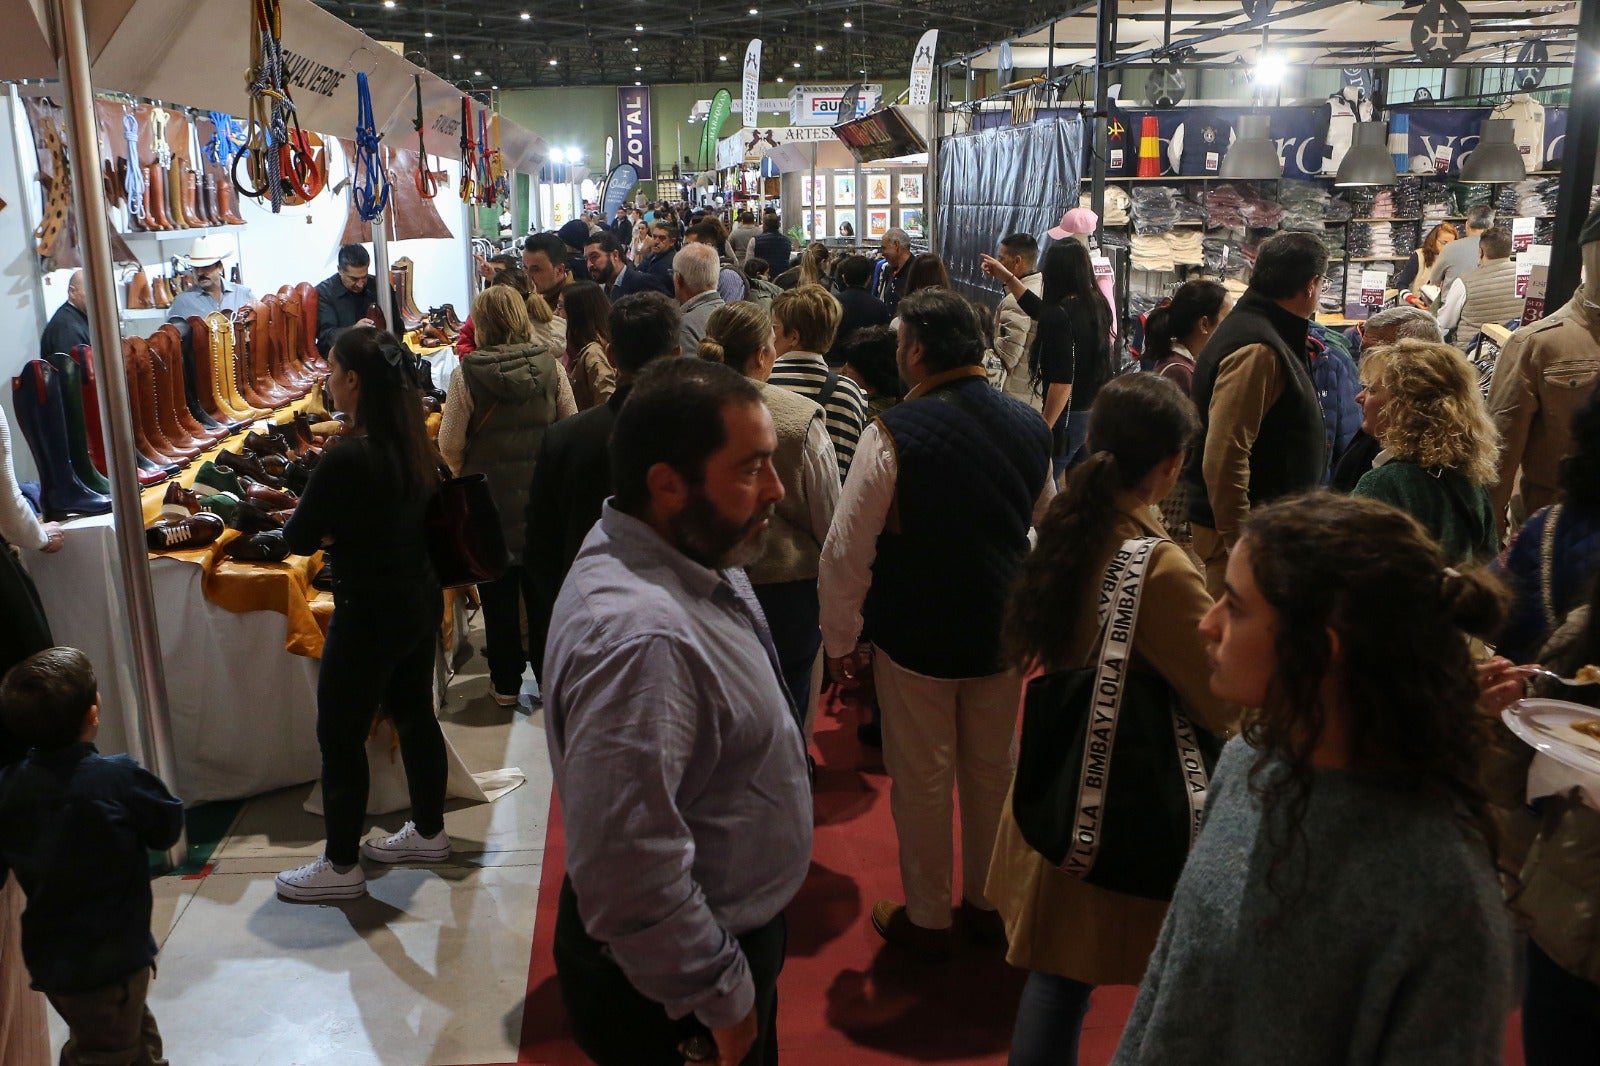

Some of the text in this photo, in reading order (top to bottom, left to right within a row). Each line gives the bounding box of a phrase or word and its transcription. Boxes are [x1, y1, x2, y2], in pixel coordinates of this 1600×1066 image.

[289, 55, 346, 97] VALVERDE
[626, 96, 643, 168] ZOTAL
[1361, 295, 1375, 303] 59
[1097, 658, 1123, 708] LOLA
[1182, 748, 1206, 794] LOLA
[1075, 805, 1099, 857] LOLA
